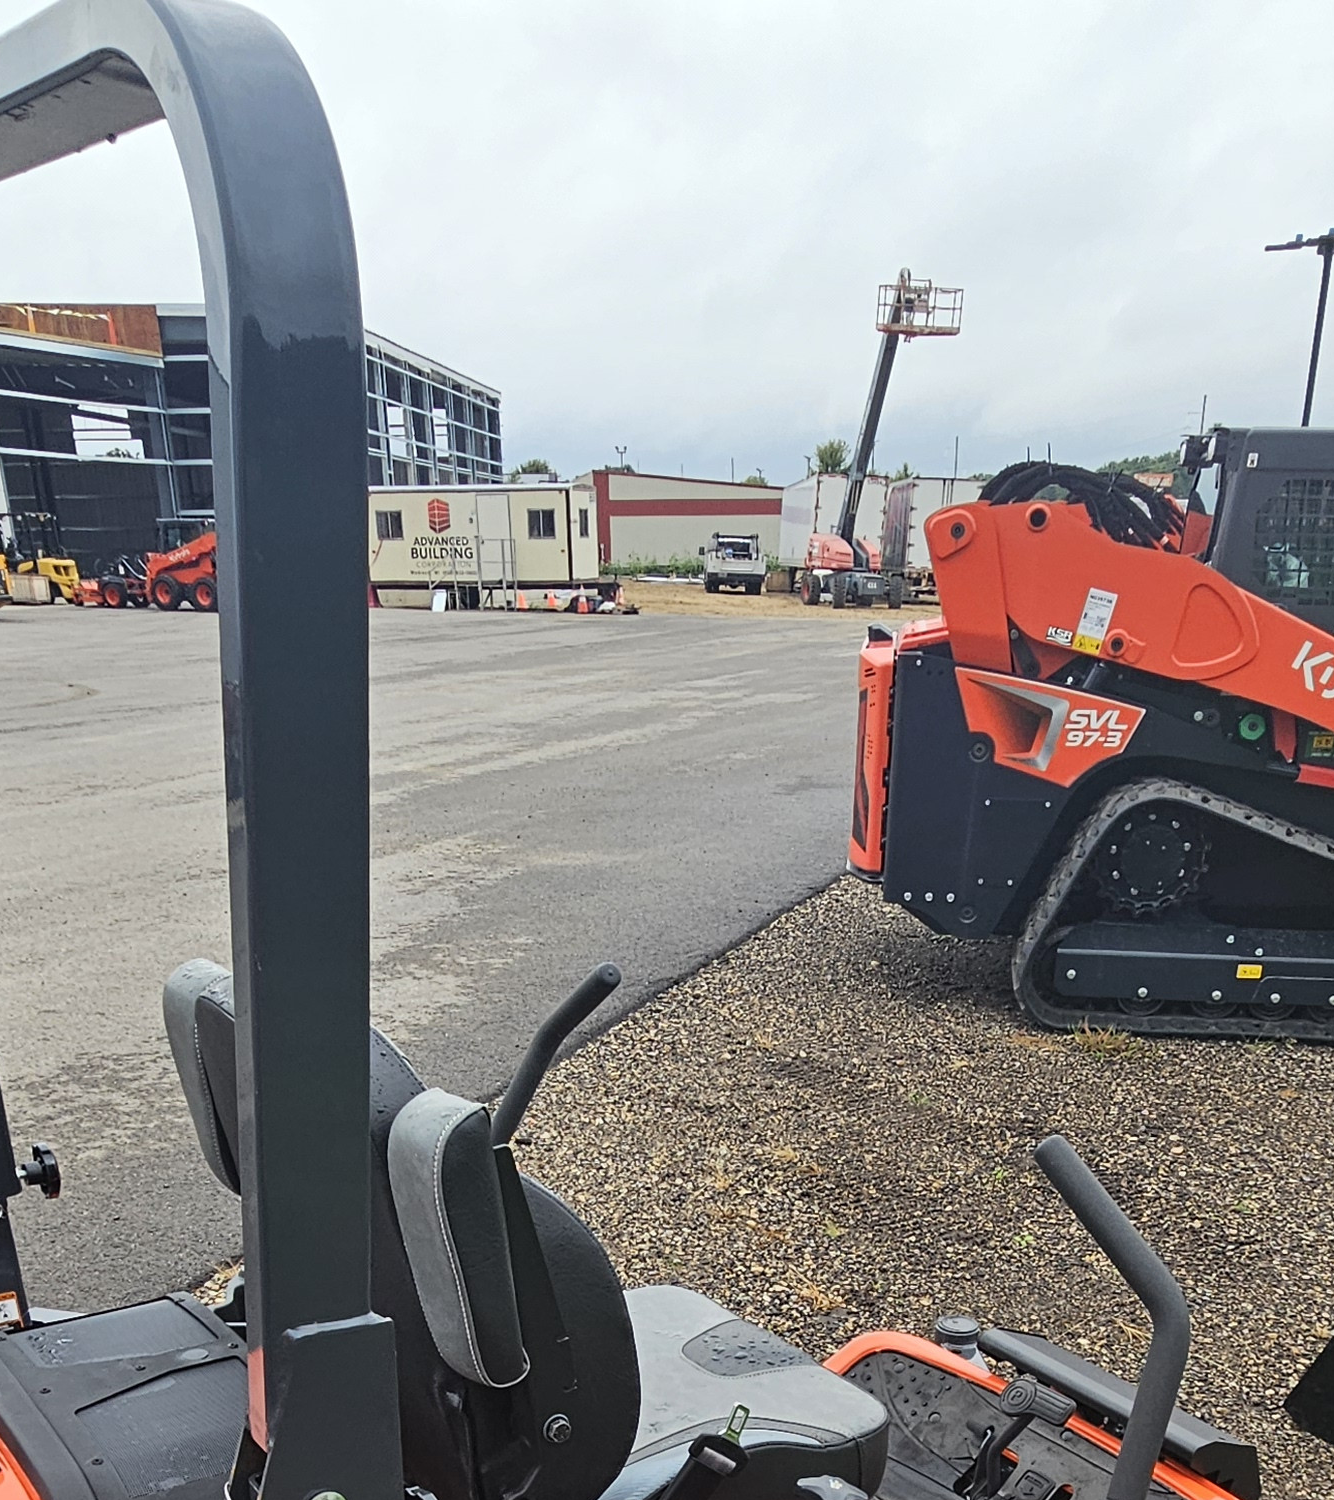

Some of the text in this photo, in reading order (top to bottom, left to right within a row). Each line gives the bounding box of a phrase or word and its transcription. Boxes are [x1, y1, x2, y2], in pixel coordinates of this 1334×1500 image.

[413, 536, 469, 546] ADVANCED
[411, 547, 473, 560] BUILDING
[1064, 709, 1128, 730] SVL
[1064, 731, 1123, 747] 97-3
